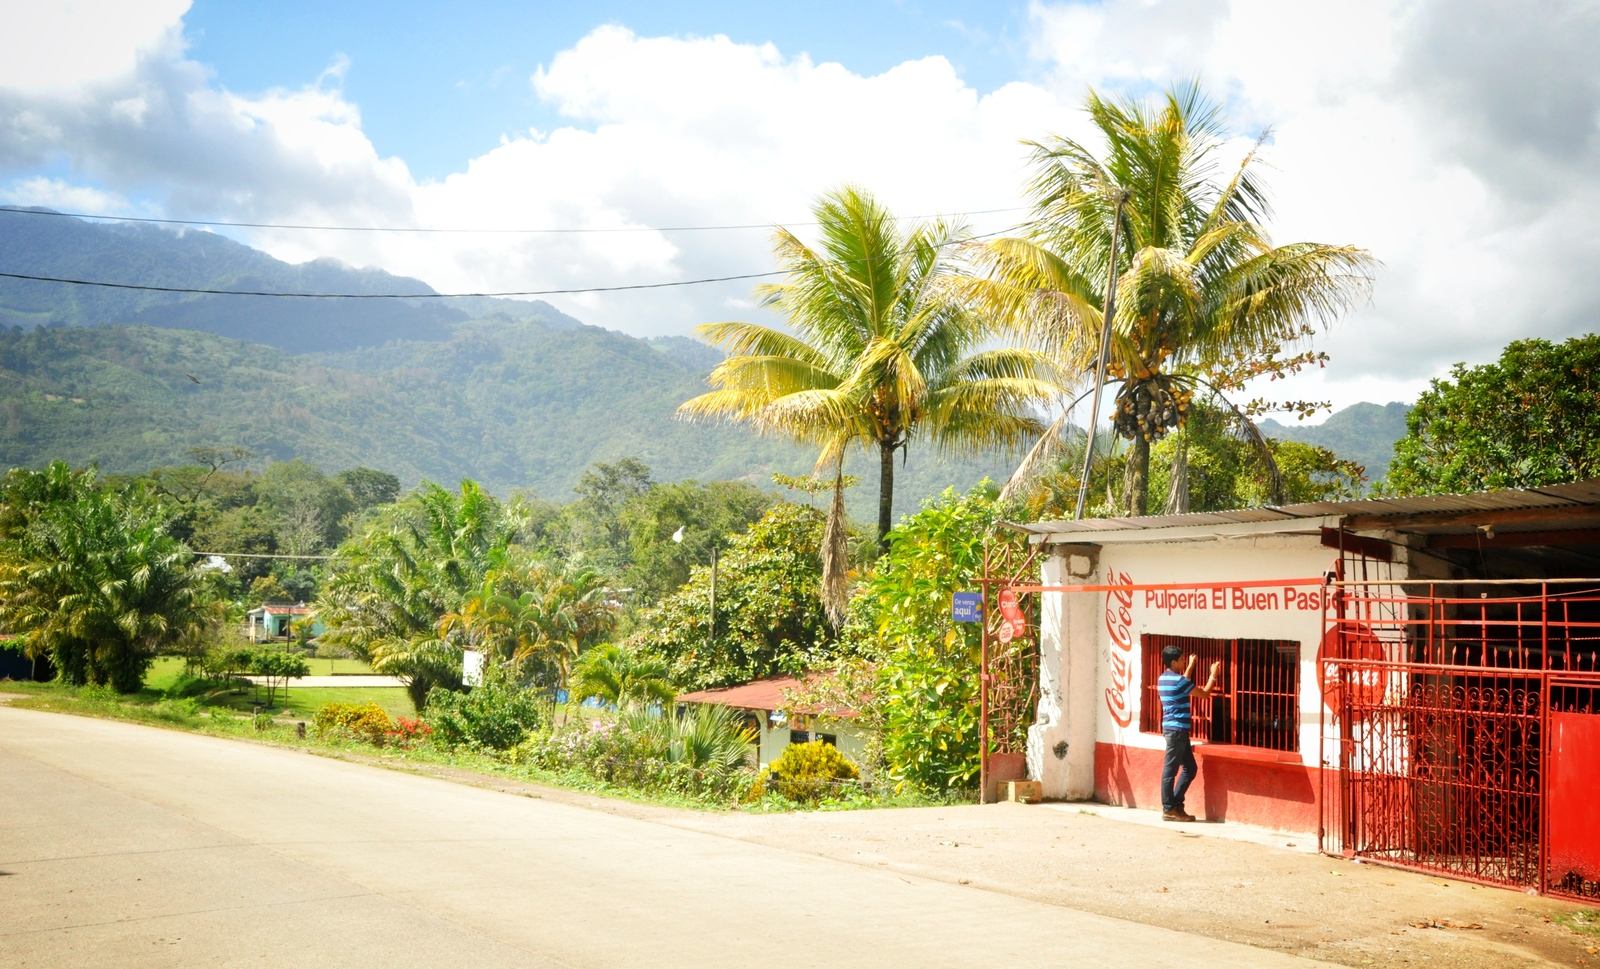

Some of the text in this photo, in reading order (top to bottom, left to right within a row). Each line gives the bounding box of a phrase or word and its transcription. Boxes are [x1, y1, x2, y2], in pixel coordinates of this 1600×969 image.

[1145, 588, 1207, 616] Pulpería
[1212, 587, 1227, 609] El
[1232, 587, 1278, 610] Buen
